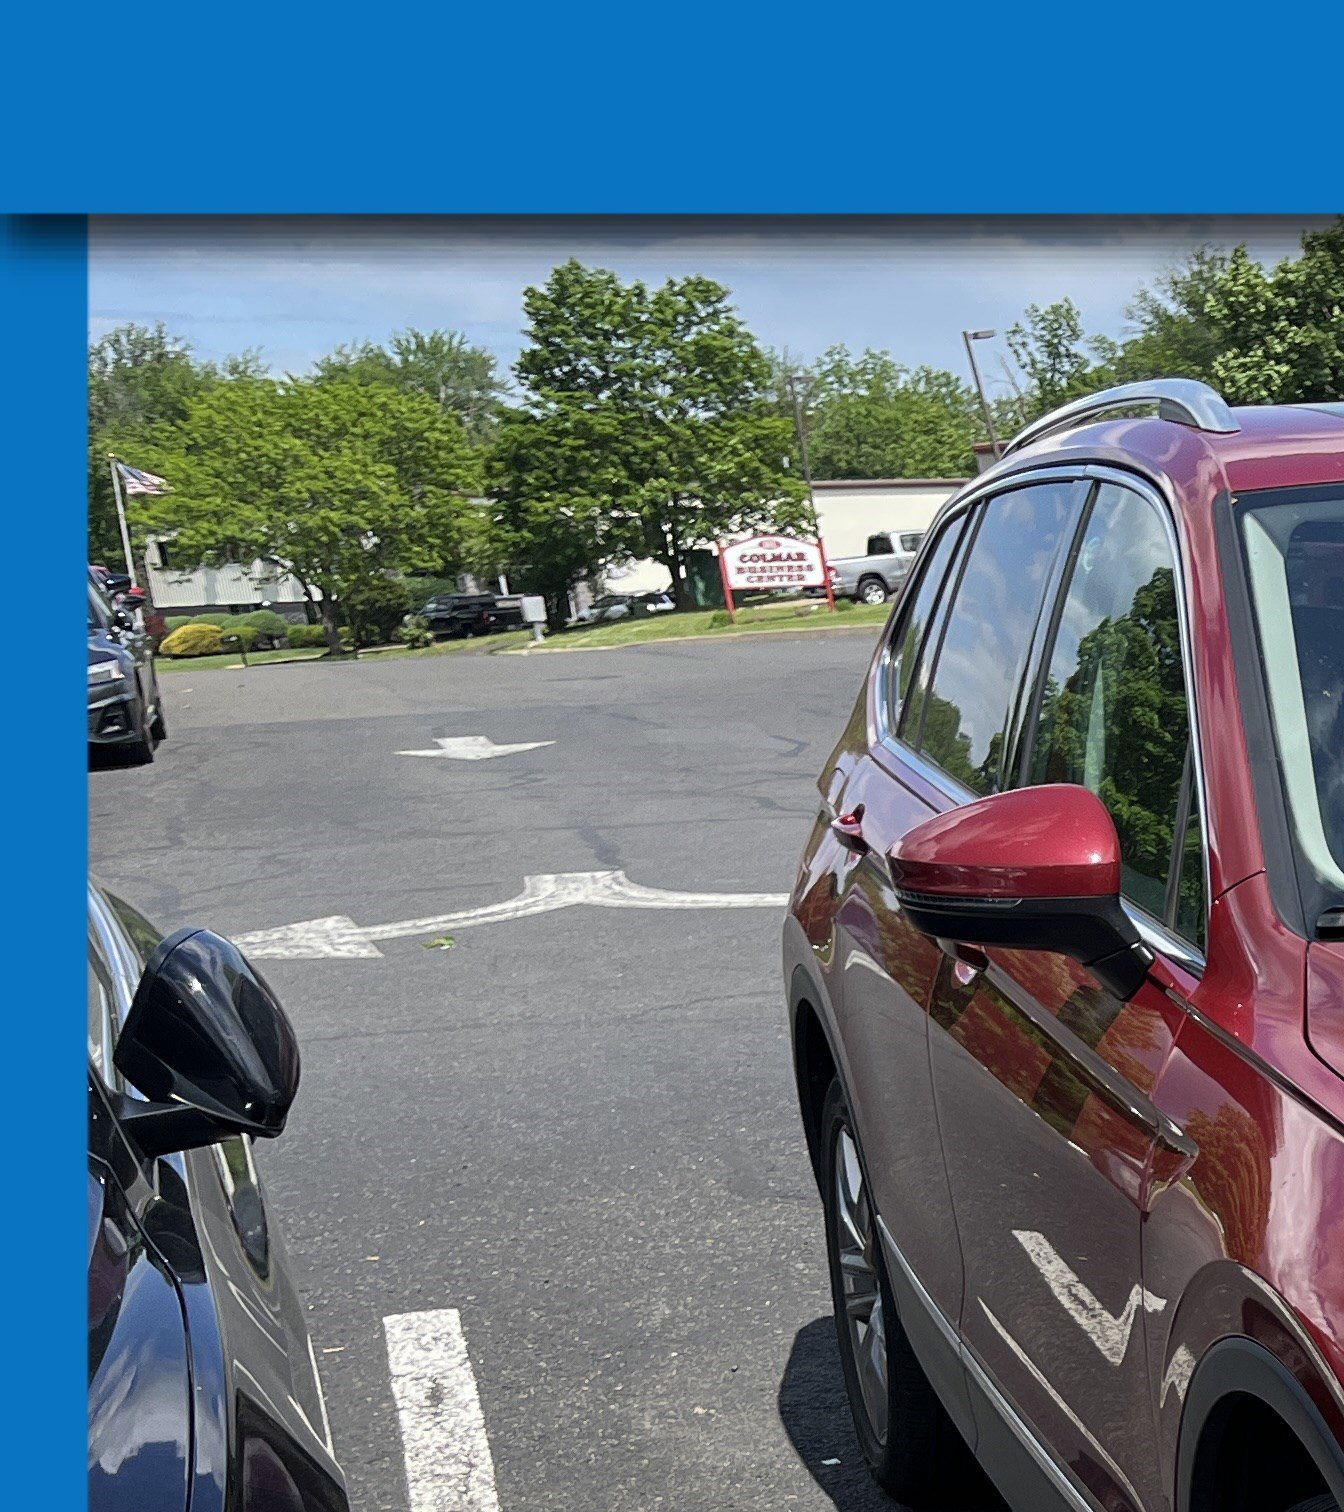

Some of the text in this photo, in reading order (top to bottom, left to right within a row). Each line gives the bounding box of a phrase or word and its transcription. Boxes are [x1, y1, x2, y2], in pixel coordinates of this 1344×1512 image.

[739, 552, 808, 563] COLMAR
[735, 564, 815, 575] BUSINESS
[746, 573, 806, 584] CENTER
